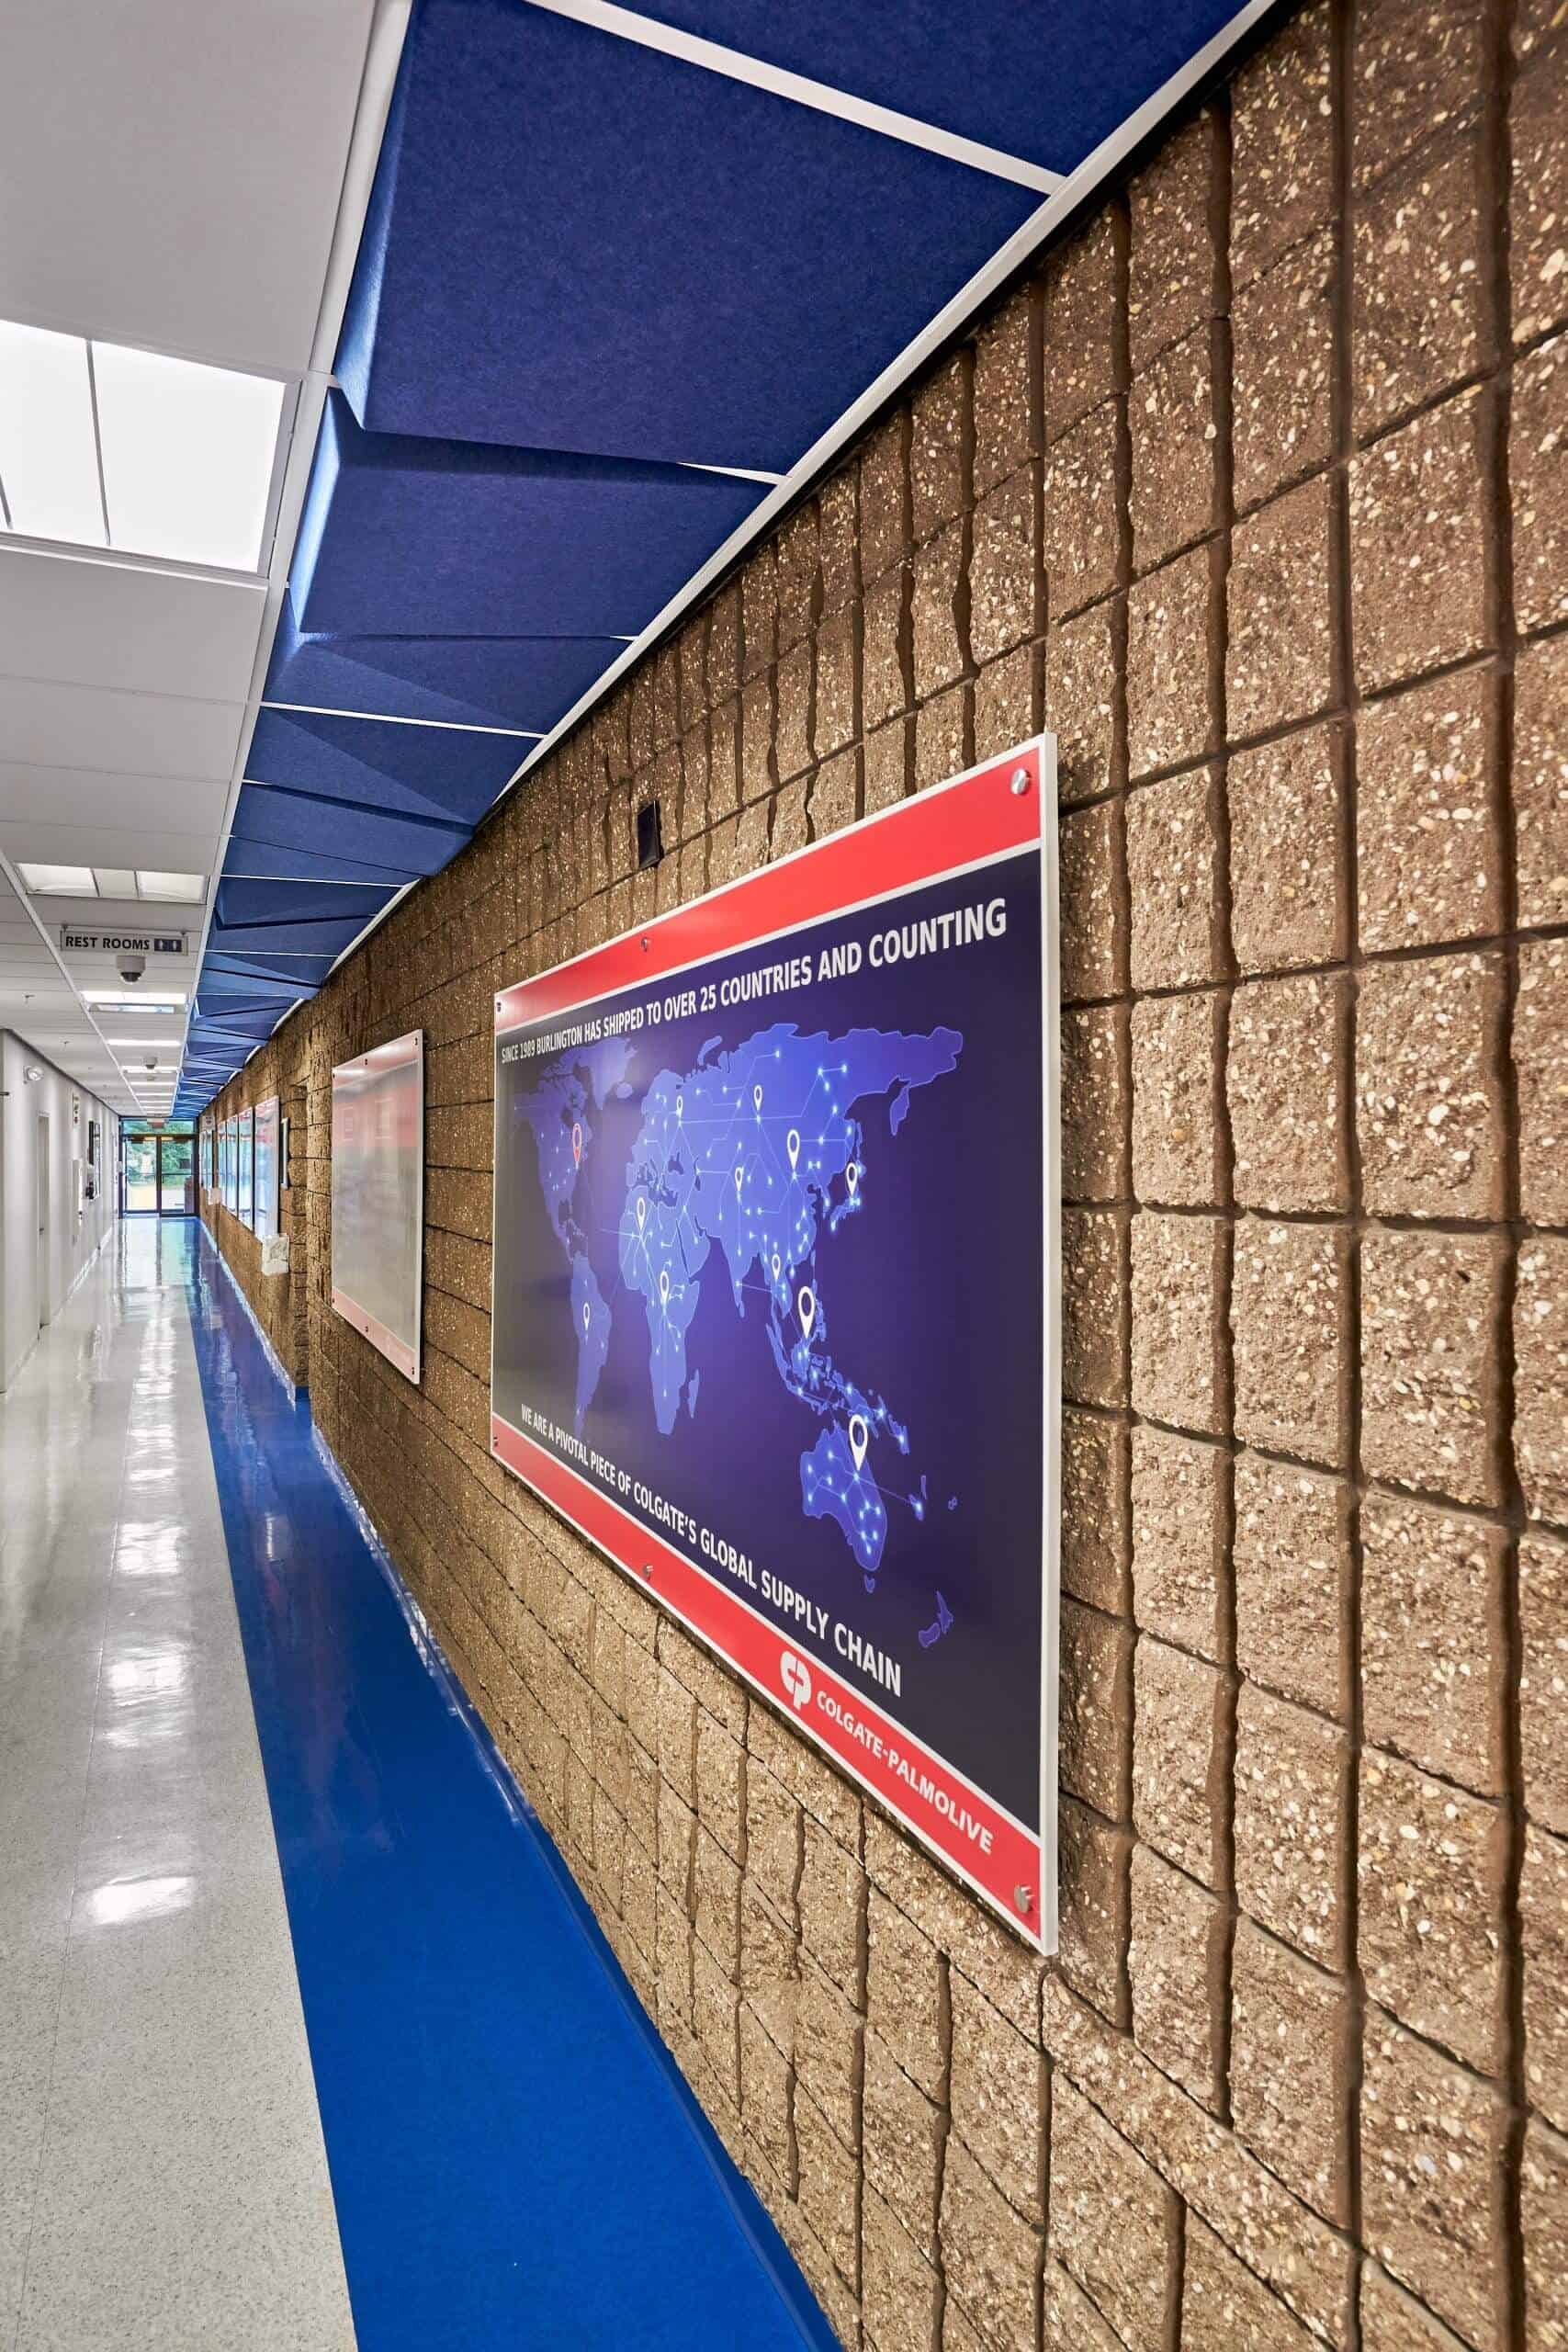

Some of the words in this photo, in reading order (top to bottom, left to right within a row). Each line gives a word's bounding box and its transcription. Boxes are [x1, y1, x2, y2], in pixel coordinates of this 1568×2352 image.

[65, 935, 97, 948] REST
[103, 937, 150, 950] ROOMS
[501, 1044, 519, 1064] SINCE
[536, 1024, 582, 1056] BURLINGTON
[584, 1019, 602, 1043] HAS
[604, 1007, 644, 1037] SHIPPED
[647, 1001, 661, 1024] TO
[664, 990, 695, 1022] OVER
[700, 984, 716, 1012] 25
[721, 955, 812, 1006] COUNTRIES
[818, 942, 862, 982] AND
[869, 897, 1007, 967] COUNTING
[521, 1403, 532, 1423] WE
[533, 1412, 547, 1435] ARE
[548, 1422, 555, 1442] A
[556, 1427, 589, 1465] PIVOTAL
[591, 1451, 615, 1486] PIECE
[617, 1470, 632, 1496] OF
[634, 1481, 696, 1544] COLGATE'S
[700, 1528, 757, 1589] GLOBAL
[761, 1569, 829, 1640] SUPPLY
[834, 1623, 901, 1698] CHAIN
[816, 1690, 994, 1854] COLGATE-PALMOLIVE
